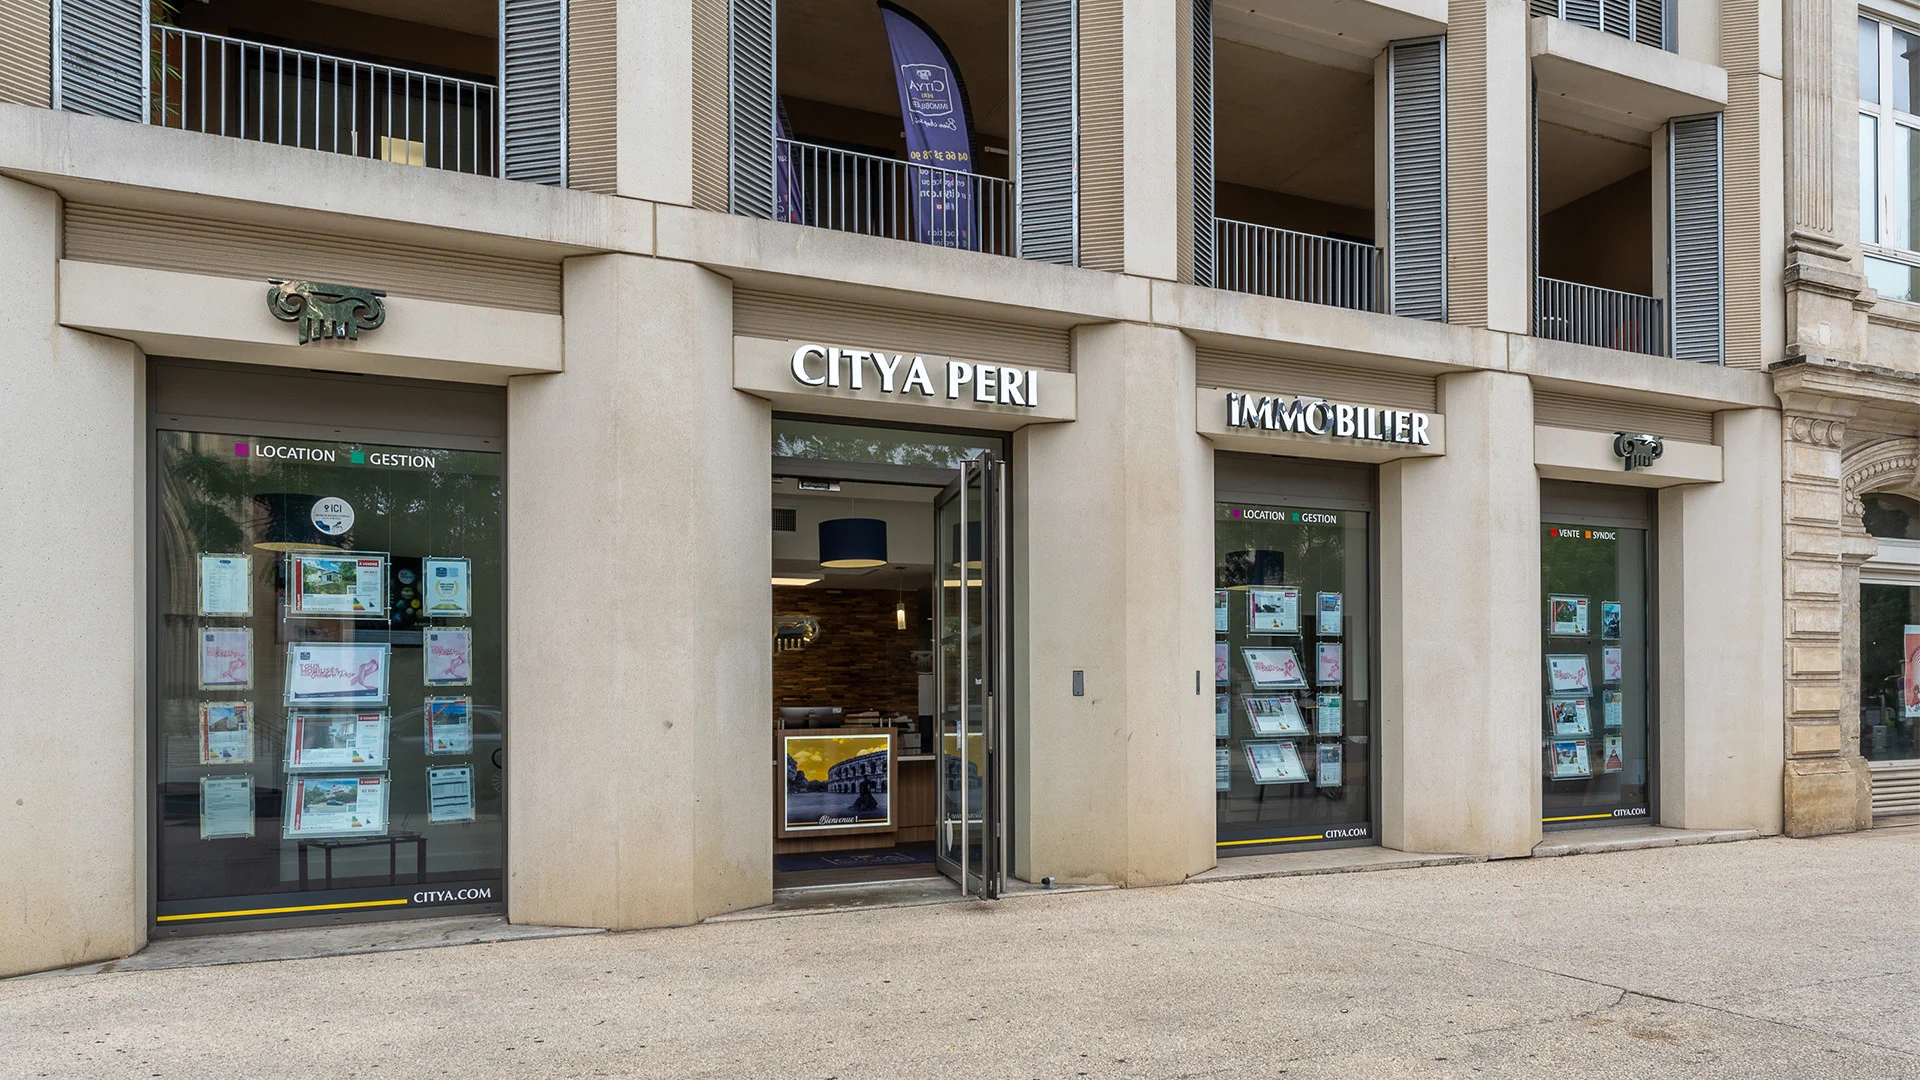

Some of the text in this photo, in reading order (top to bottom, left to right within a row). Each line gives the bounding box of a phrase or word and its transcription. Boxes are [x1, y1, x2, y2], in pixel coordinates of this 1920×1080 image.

[791, 344, 1038, 407] CITYA PERI
[1227, 391, 1430, 445] IMMOBILIER
[256, 445, 335, 462] LOCATION
[370, 453, 436, 468] GESTION
[331, 504, 342, 512] ICI
[1243, 509, 1285, 520] LOCATION
[1301, 513, 1337, 524] GESTION
[1559, 529, 1580, 538] VENTE
[1592, 531, 1616, 540] SYNDIC
[1613, 807, 1646, 817] CITYA.COM
[819, 815, 855, 825] Bienvenue
[1325, 828, 1367, 838] CITYA.COM
[413, 888, 491, 903] CITYA.COM
